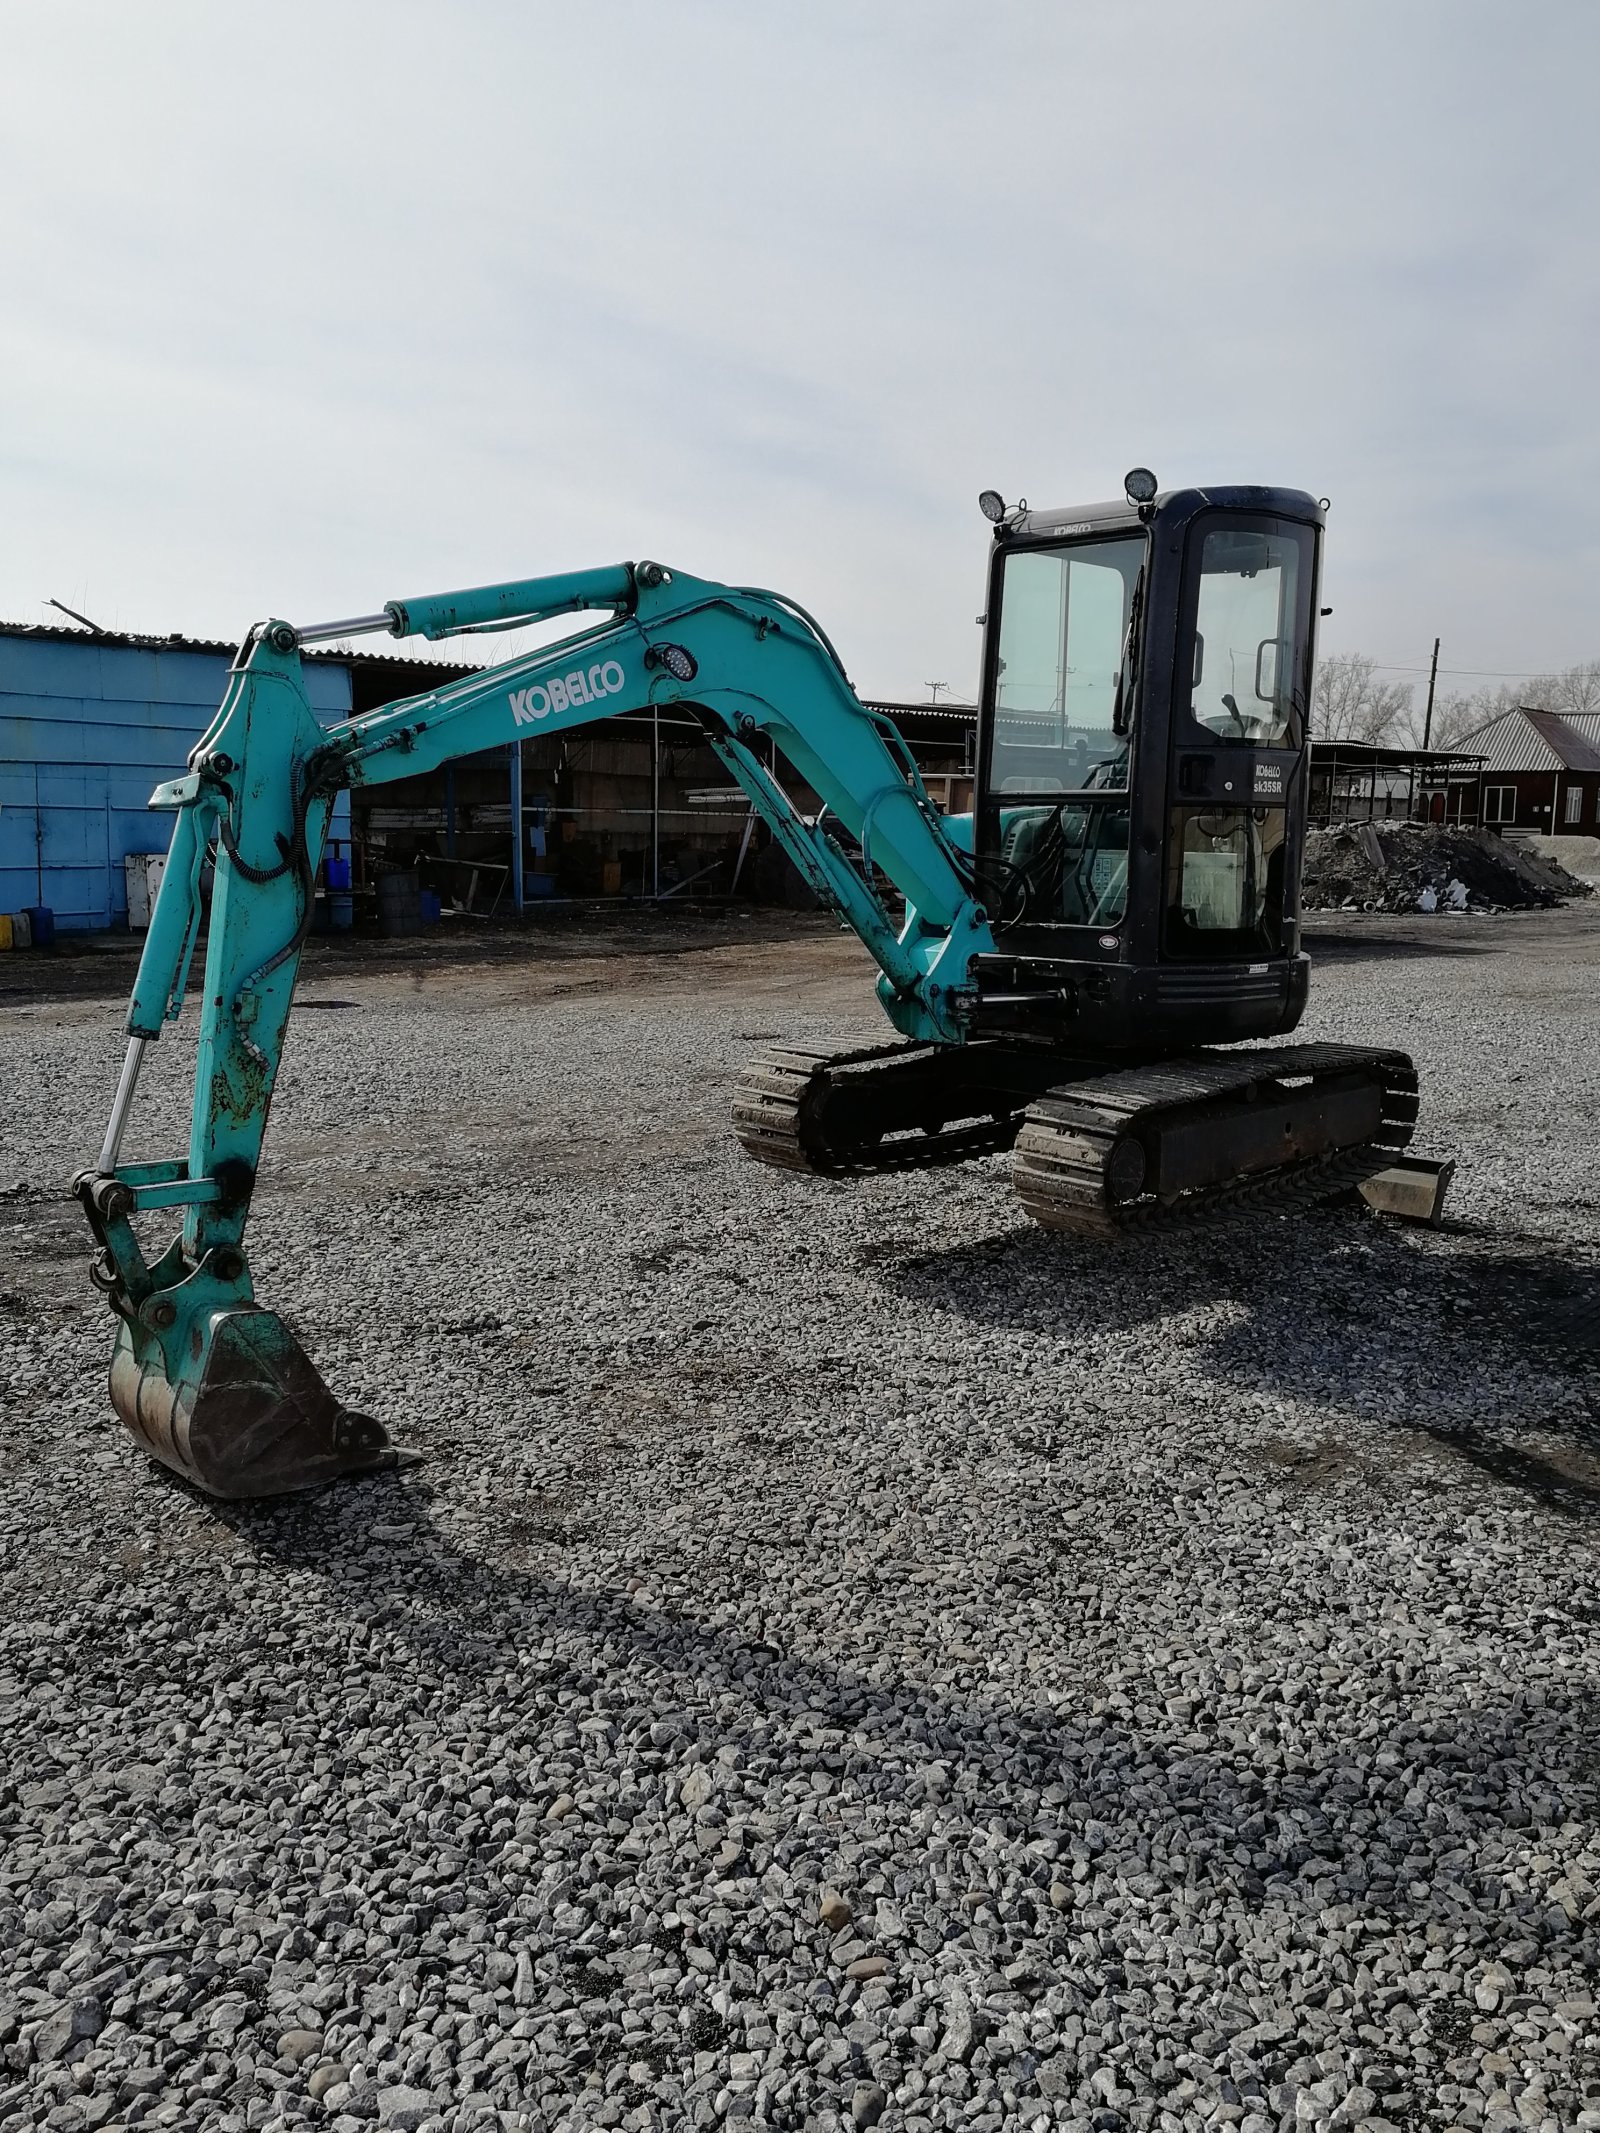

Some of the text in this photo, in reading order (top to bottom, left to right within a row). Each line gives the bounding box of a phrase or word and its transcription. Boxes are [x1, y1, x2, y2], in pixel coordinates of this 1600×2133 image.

[508, 660, 625, 727] KOBELCO
[1255, 764, 1281, 778] KOBELCO
[1253, 780, 1282, 793] sk35SR
